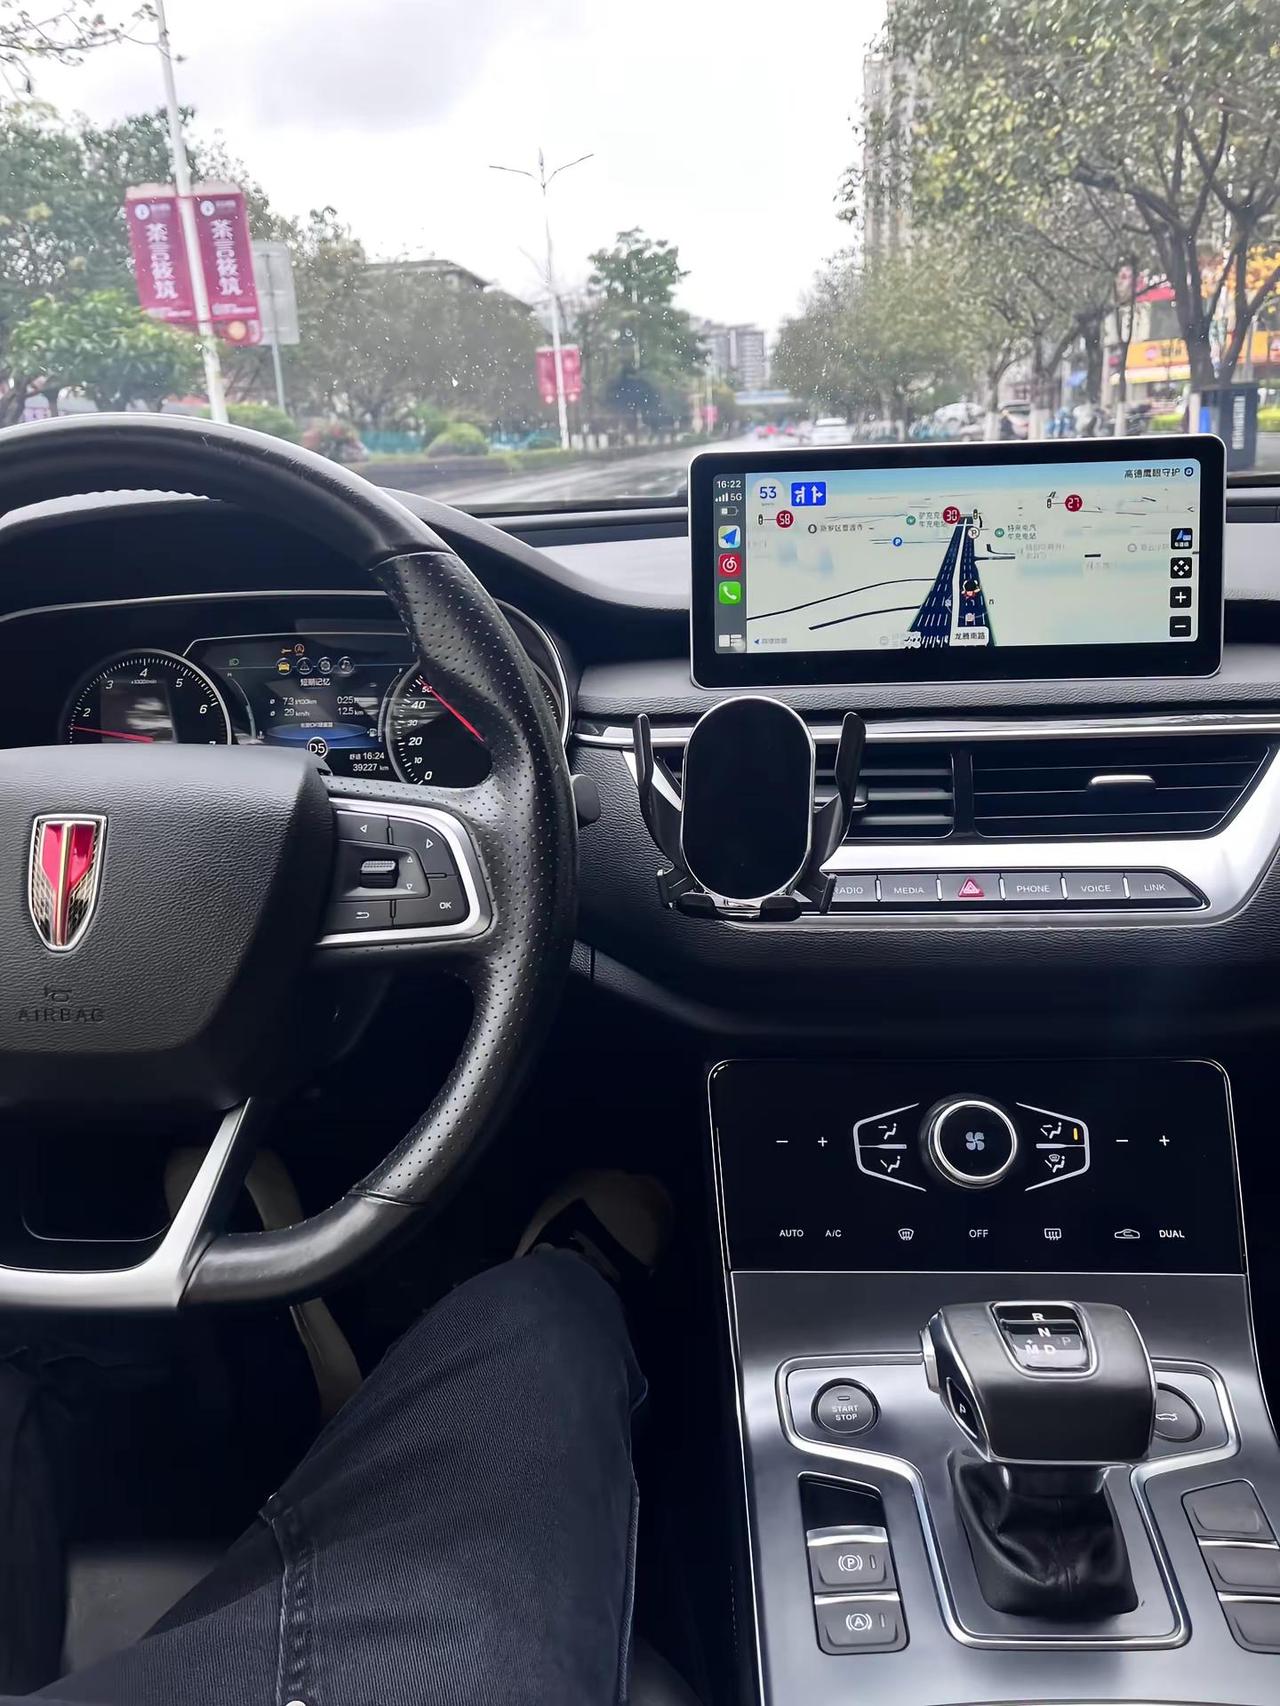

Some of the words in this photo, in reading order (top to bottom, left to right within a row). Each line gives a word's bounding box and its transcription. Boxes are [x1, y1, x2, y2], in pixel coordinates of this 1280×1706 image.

[717, 479, 741, 489] 16:22
[730, 493, 743, 501] 5G
[760, 486, 777, 499] 53
[140, 667, 148, 677] 4
[105, 680, 114, 690] 3
[175, 678, 183, 688] 5
[300, 677, 331, 686] 短期记忆
[199, 704, 208, 714] 6
[411, 700, 426, 709] 40
[83, 708, 91, 717] 2
[284, 708, 295, 717] 29
[408, 737, 423, 746] 20
[309, 743, 325, 754] D5
[362, 752, 385, 760] 16:24
[413, 756, 423, 764] 10
[352, 763, 378, 772] 39227
[424, 770, 433, 780] 0
[893, 887, 925, 895] MEDIA
[1016, 884, 1051, 893] PHONE
[1080, 884, 1112, 893] VOICE
[1144, 883, 1167, 892] LINK
[439, 901, 452, 910] OK
[18, 1007, 104, 1022] AIRBAG
[779, 1229, 804, 1238] AUTO
[825, 1229, 842, 1238] A/C
[969, 1229, 989, 1238] OFF
[1159, 1229, 1185, 1239] DUAL
[1031, 1312, 1045, 1321] R
[1037, 1327, 1051, 1337] N
[1024, 1344, 1039, 1354] M
[1043, 1344, 1056, 1355] D
[832, 1405, 859, 1413] START
